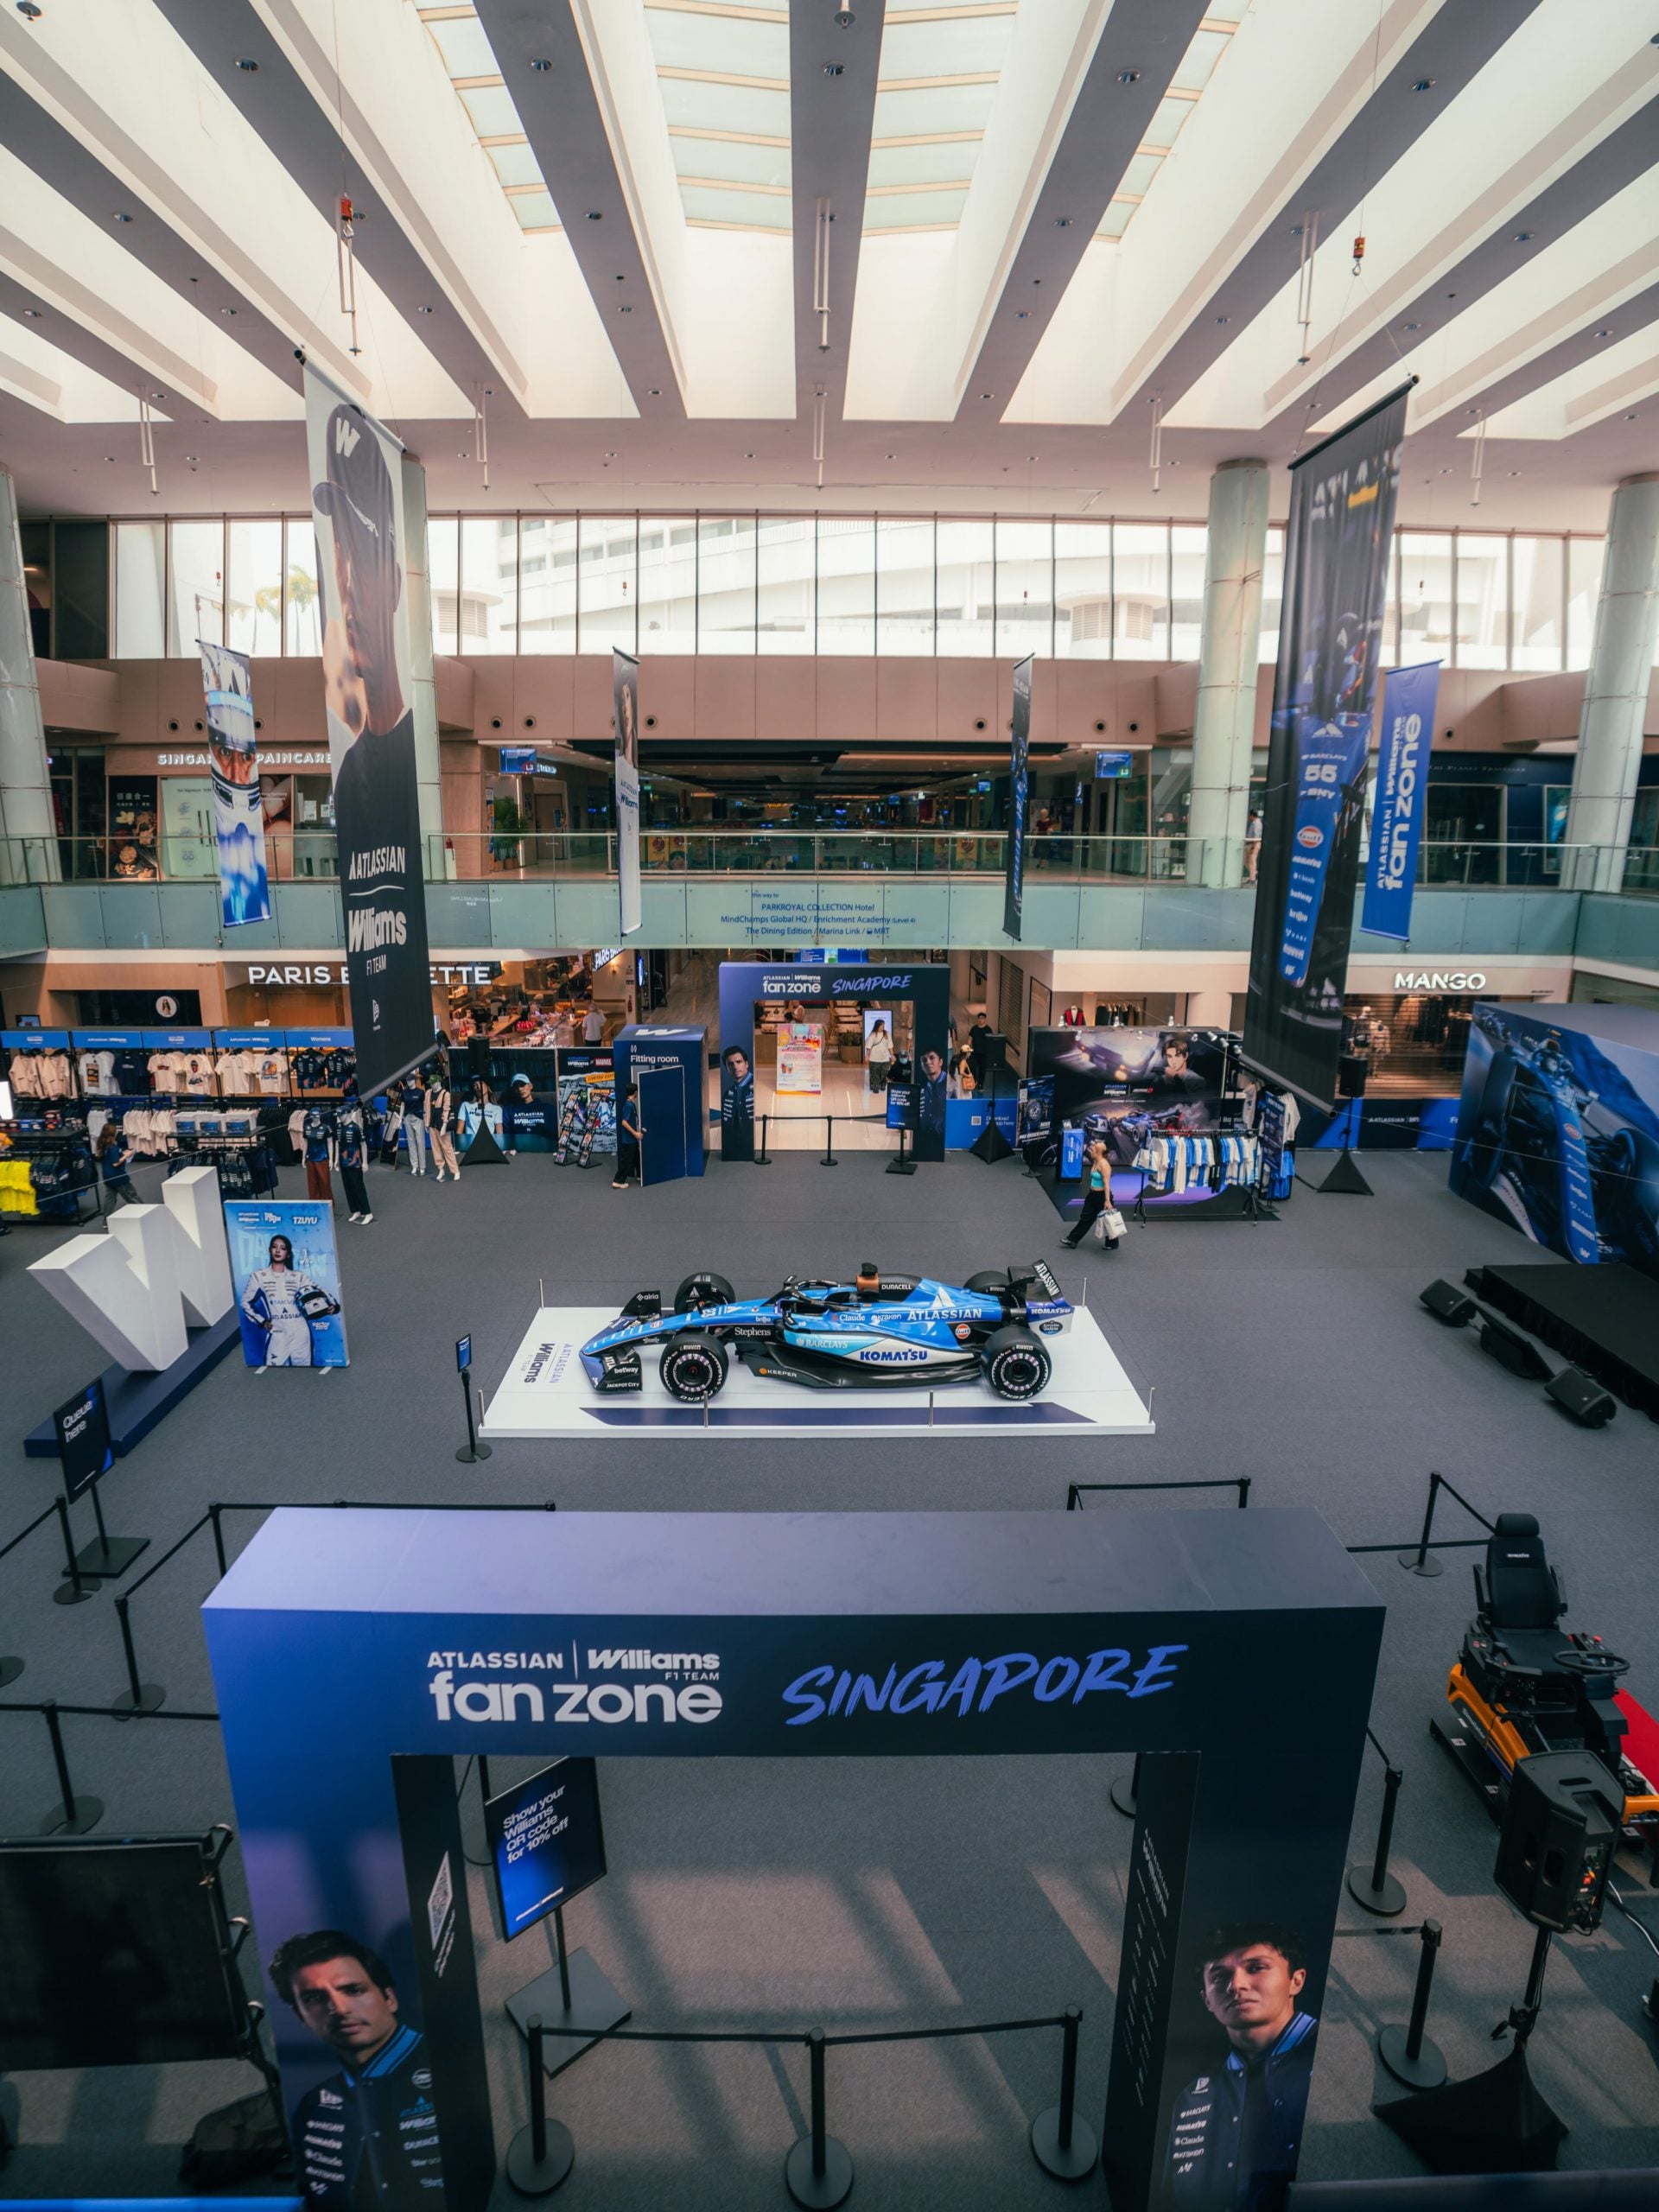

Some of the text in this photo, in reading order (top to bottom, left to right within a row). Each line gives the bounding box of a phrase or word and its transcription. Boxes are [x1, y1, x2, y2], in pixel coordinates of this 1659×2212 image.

[1376, 716, 1402, 889] ATLASSIAN Williams
[1384, 712, 1422, 891] fan zone
[356, 846, 406, 880] ATLASSIAN
[348, 907, 407, 953] Williams
[721, 915, 769, 924] MindChamps
[856, 916, 891, 925] Academy
[761, 927, 785, 936] Dining
[372, 954, 387, 975] TEAM
[248, 966, 331, 984] PARIS
[763, 975, 912, 994] fan zone SINGAPORE
[1394, 972, 1487, 990] MANGO
[630, 1054, 657, 1064] Fitting
[293, 1216, 318, 1224] TZUYU
[1034, 1262, 1059, 1296] ATLASSIAN
[839, 1313, 866, 1321] Claude
[907, 1308, 982, 1321] ATLASSIAN
[734, 1326, 771, 1338] Stephens
[805, 1339, 849, 1348] BARCLAYS
[524, 1343, 556, 1383] Williams
[549, 1347, 571, 1383] ATLASSIAN
[860, 1349, 928, 1361] KOMATSU
[613, 1366, 639, 1375] betway
[767, 1370, 798, 1378] KEEPER
[63, 1401, 92, 1429] Queue
[65, 1420, 86, 1443] here
[427, 1649, 720, 1670] ATLASSIAN Williams
[429, 1644, 1189, 1726] fan zone SINGAPORE
[664, 1672, 720, 1681] F1 TEAM
[503, 1785, 566, 1829] Show your
[504, 1805, 554, 1840] Williams
[505, 1815, 558, 1853] QR code
[507, 1816, 569, 1864] for 10% off
[1180, 2134, 1205, 2145] Claude
